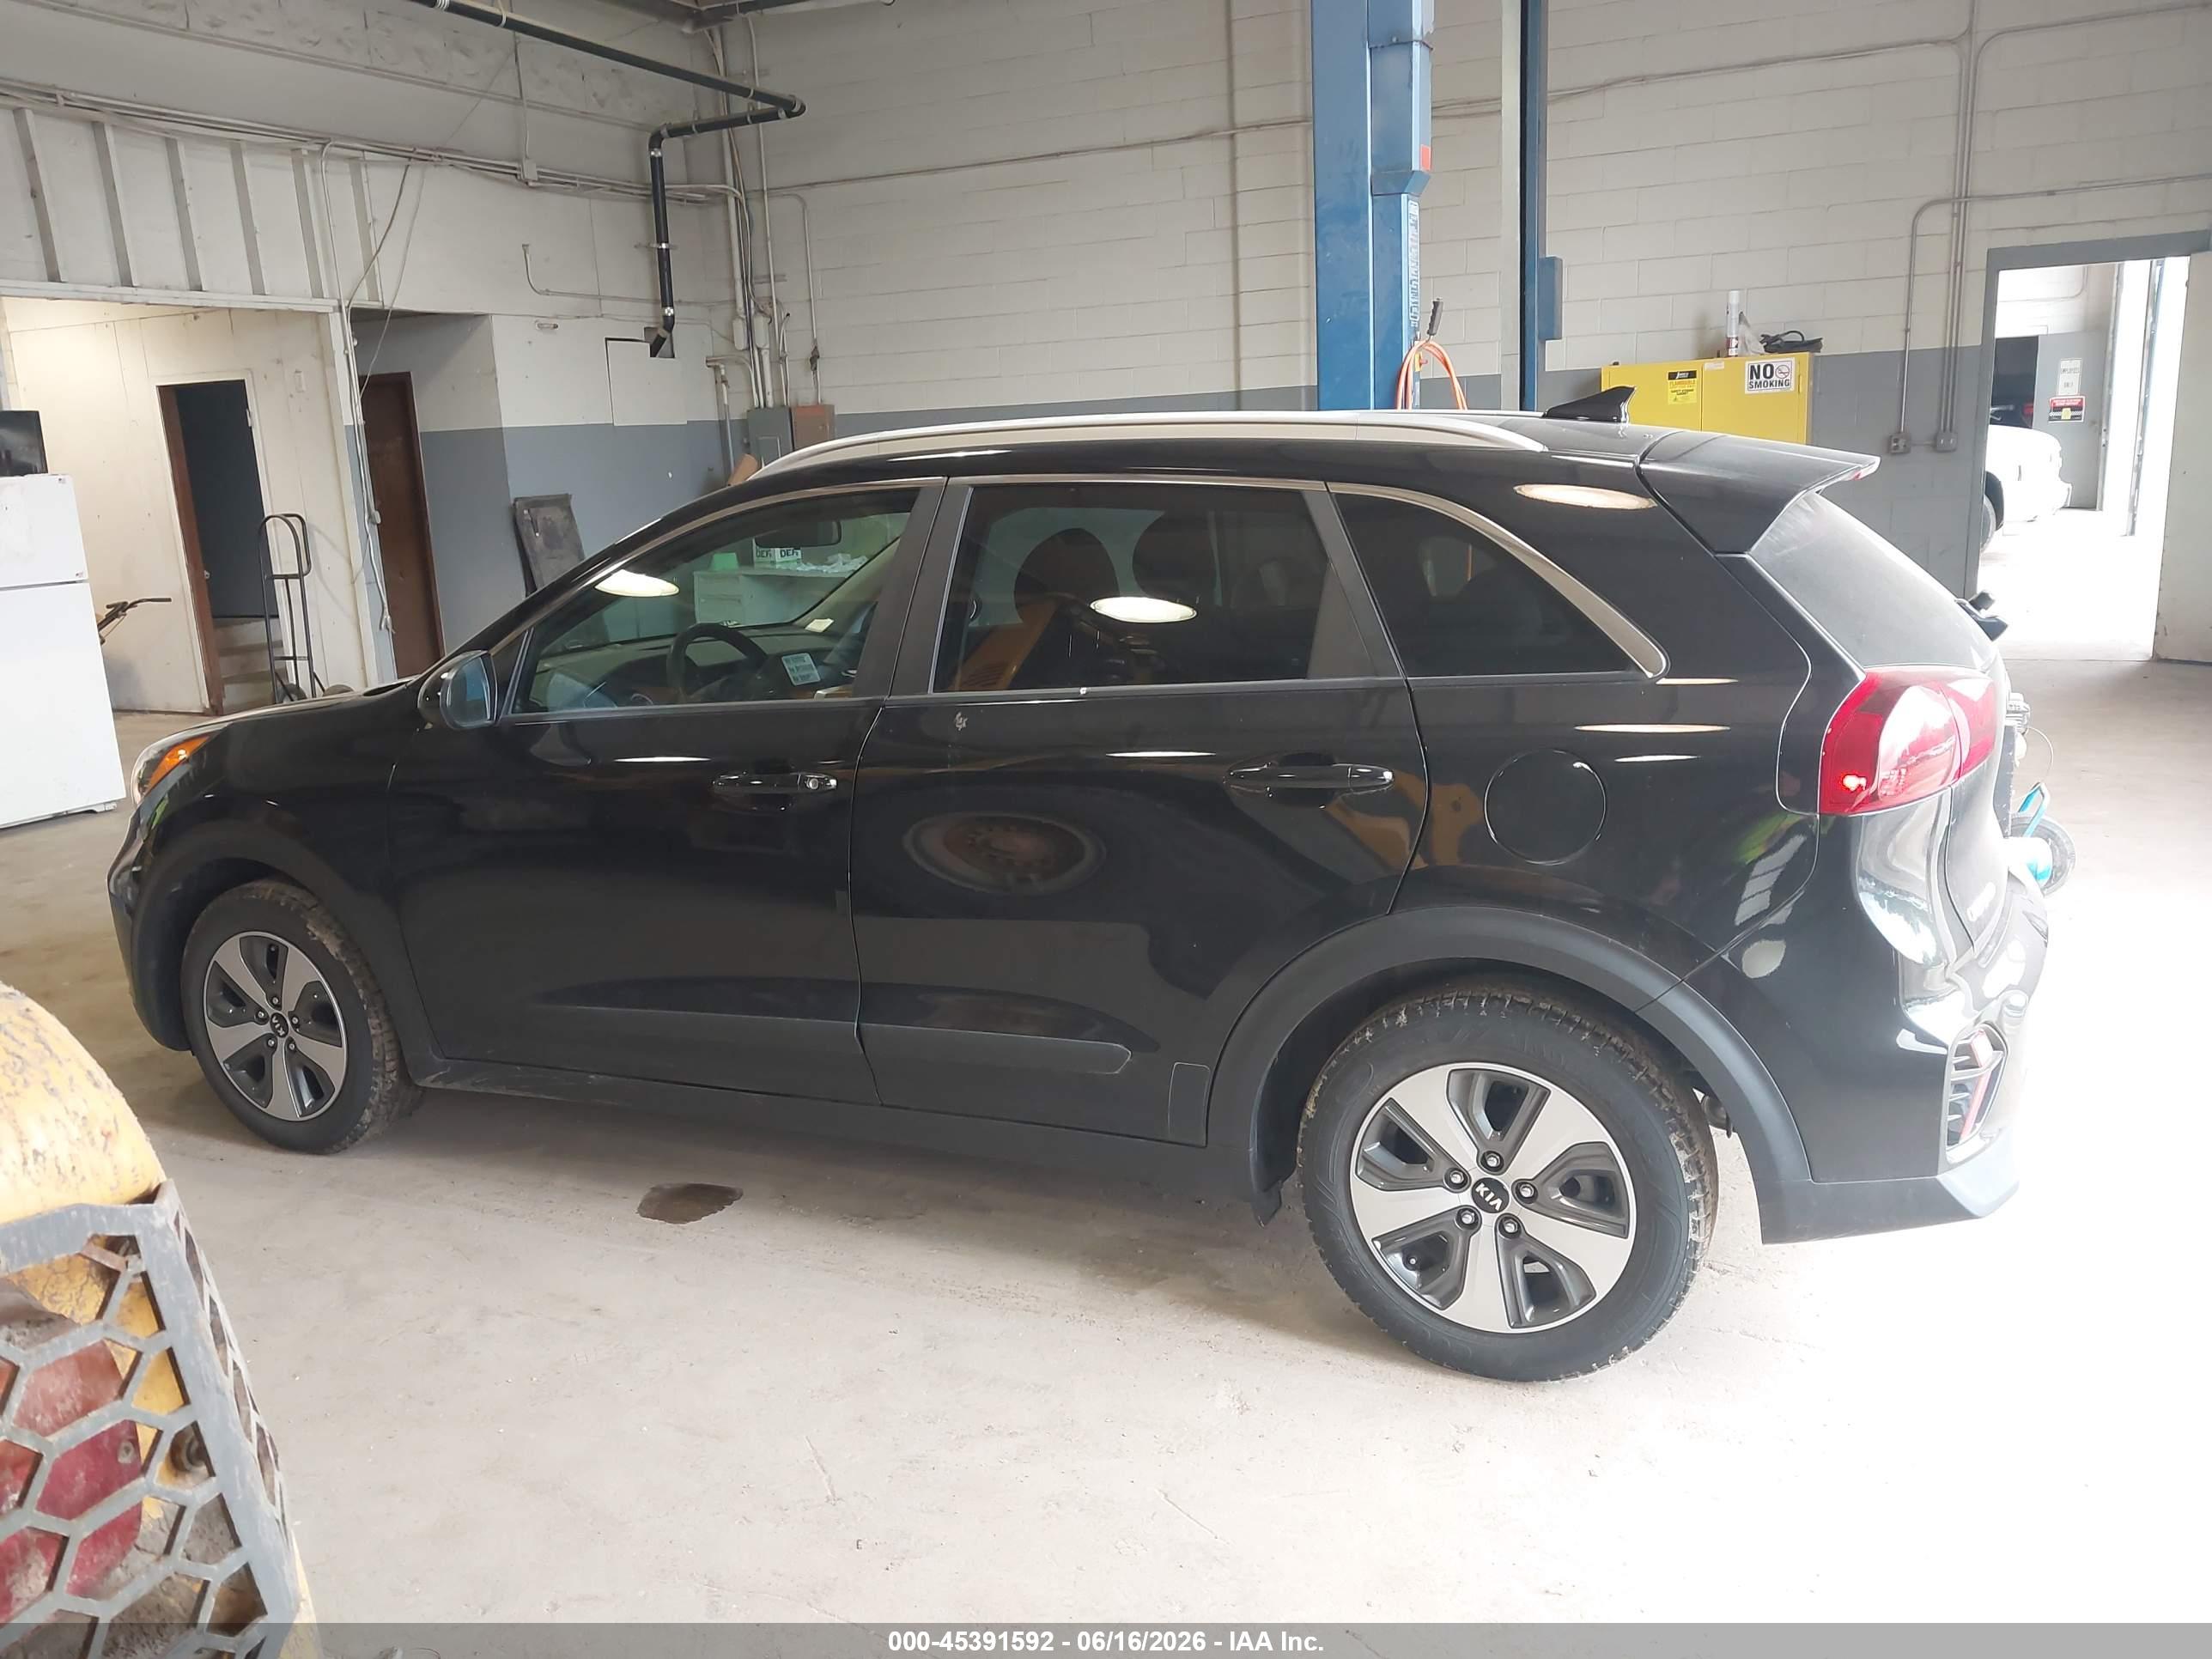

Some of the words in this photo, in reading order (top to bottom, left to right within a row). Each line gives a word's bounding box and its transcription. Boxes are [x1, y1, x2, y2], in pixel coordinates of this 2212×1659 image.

[1749, 363, 1774, 380] NO
[1748, 379, 1790, 389] SMOKING
[272, 1016, 285, 1036] KIA
[1475, 1182, 1503, 1212] KIA
